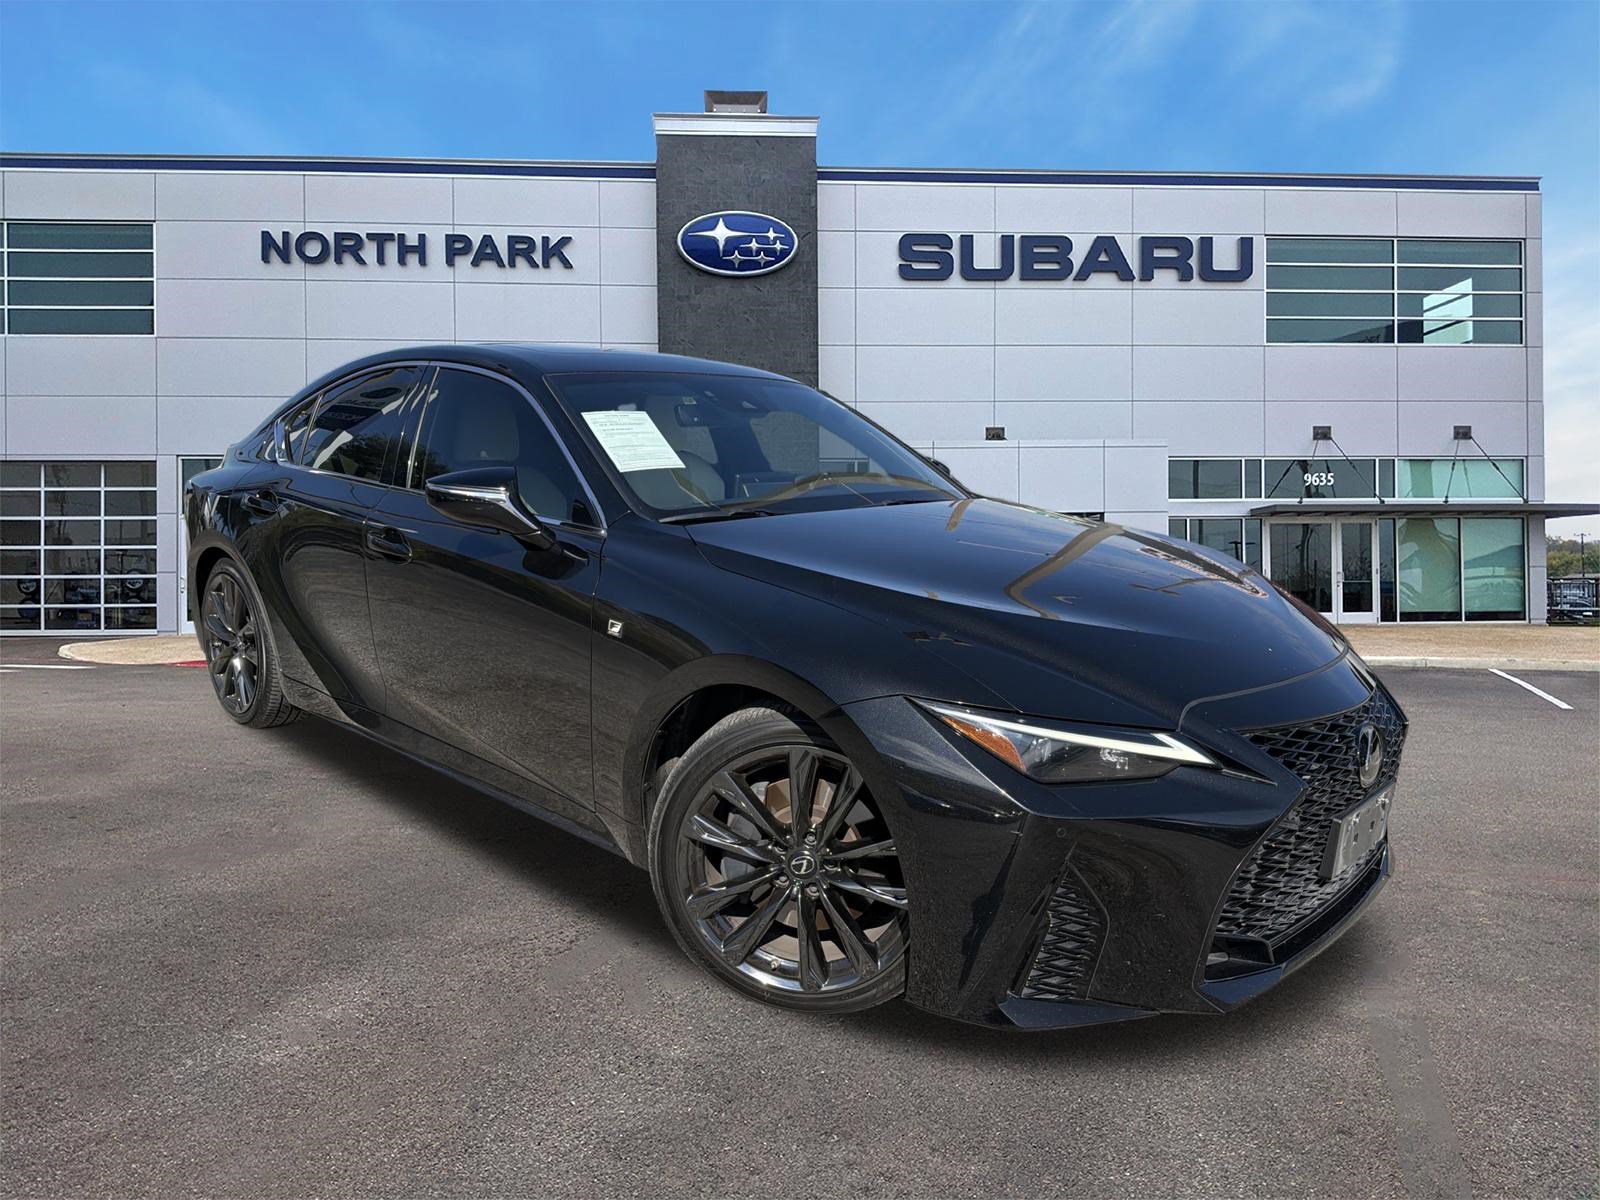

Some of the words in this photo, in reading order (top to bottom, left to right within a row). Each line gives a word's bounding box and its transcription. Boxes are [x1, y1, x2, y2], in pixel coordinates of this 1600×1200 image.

[261, 230, 427, 266] NORTH
[445, 234, 574, 269] PARK
[898, 233, 1254, 282] SUBARU
[1303, 472, 1335, 486] 9635
